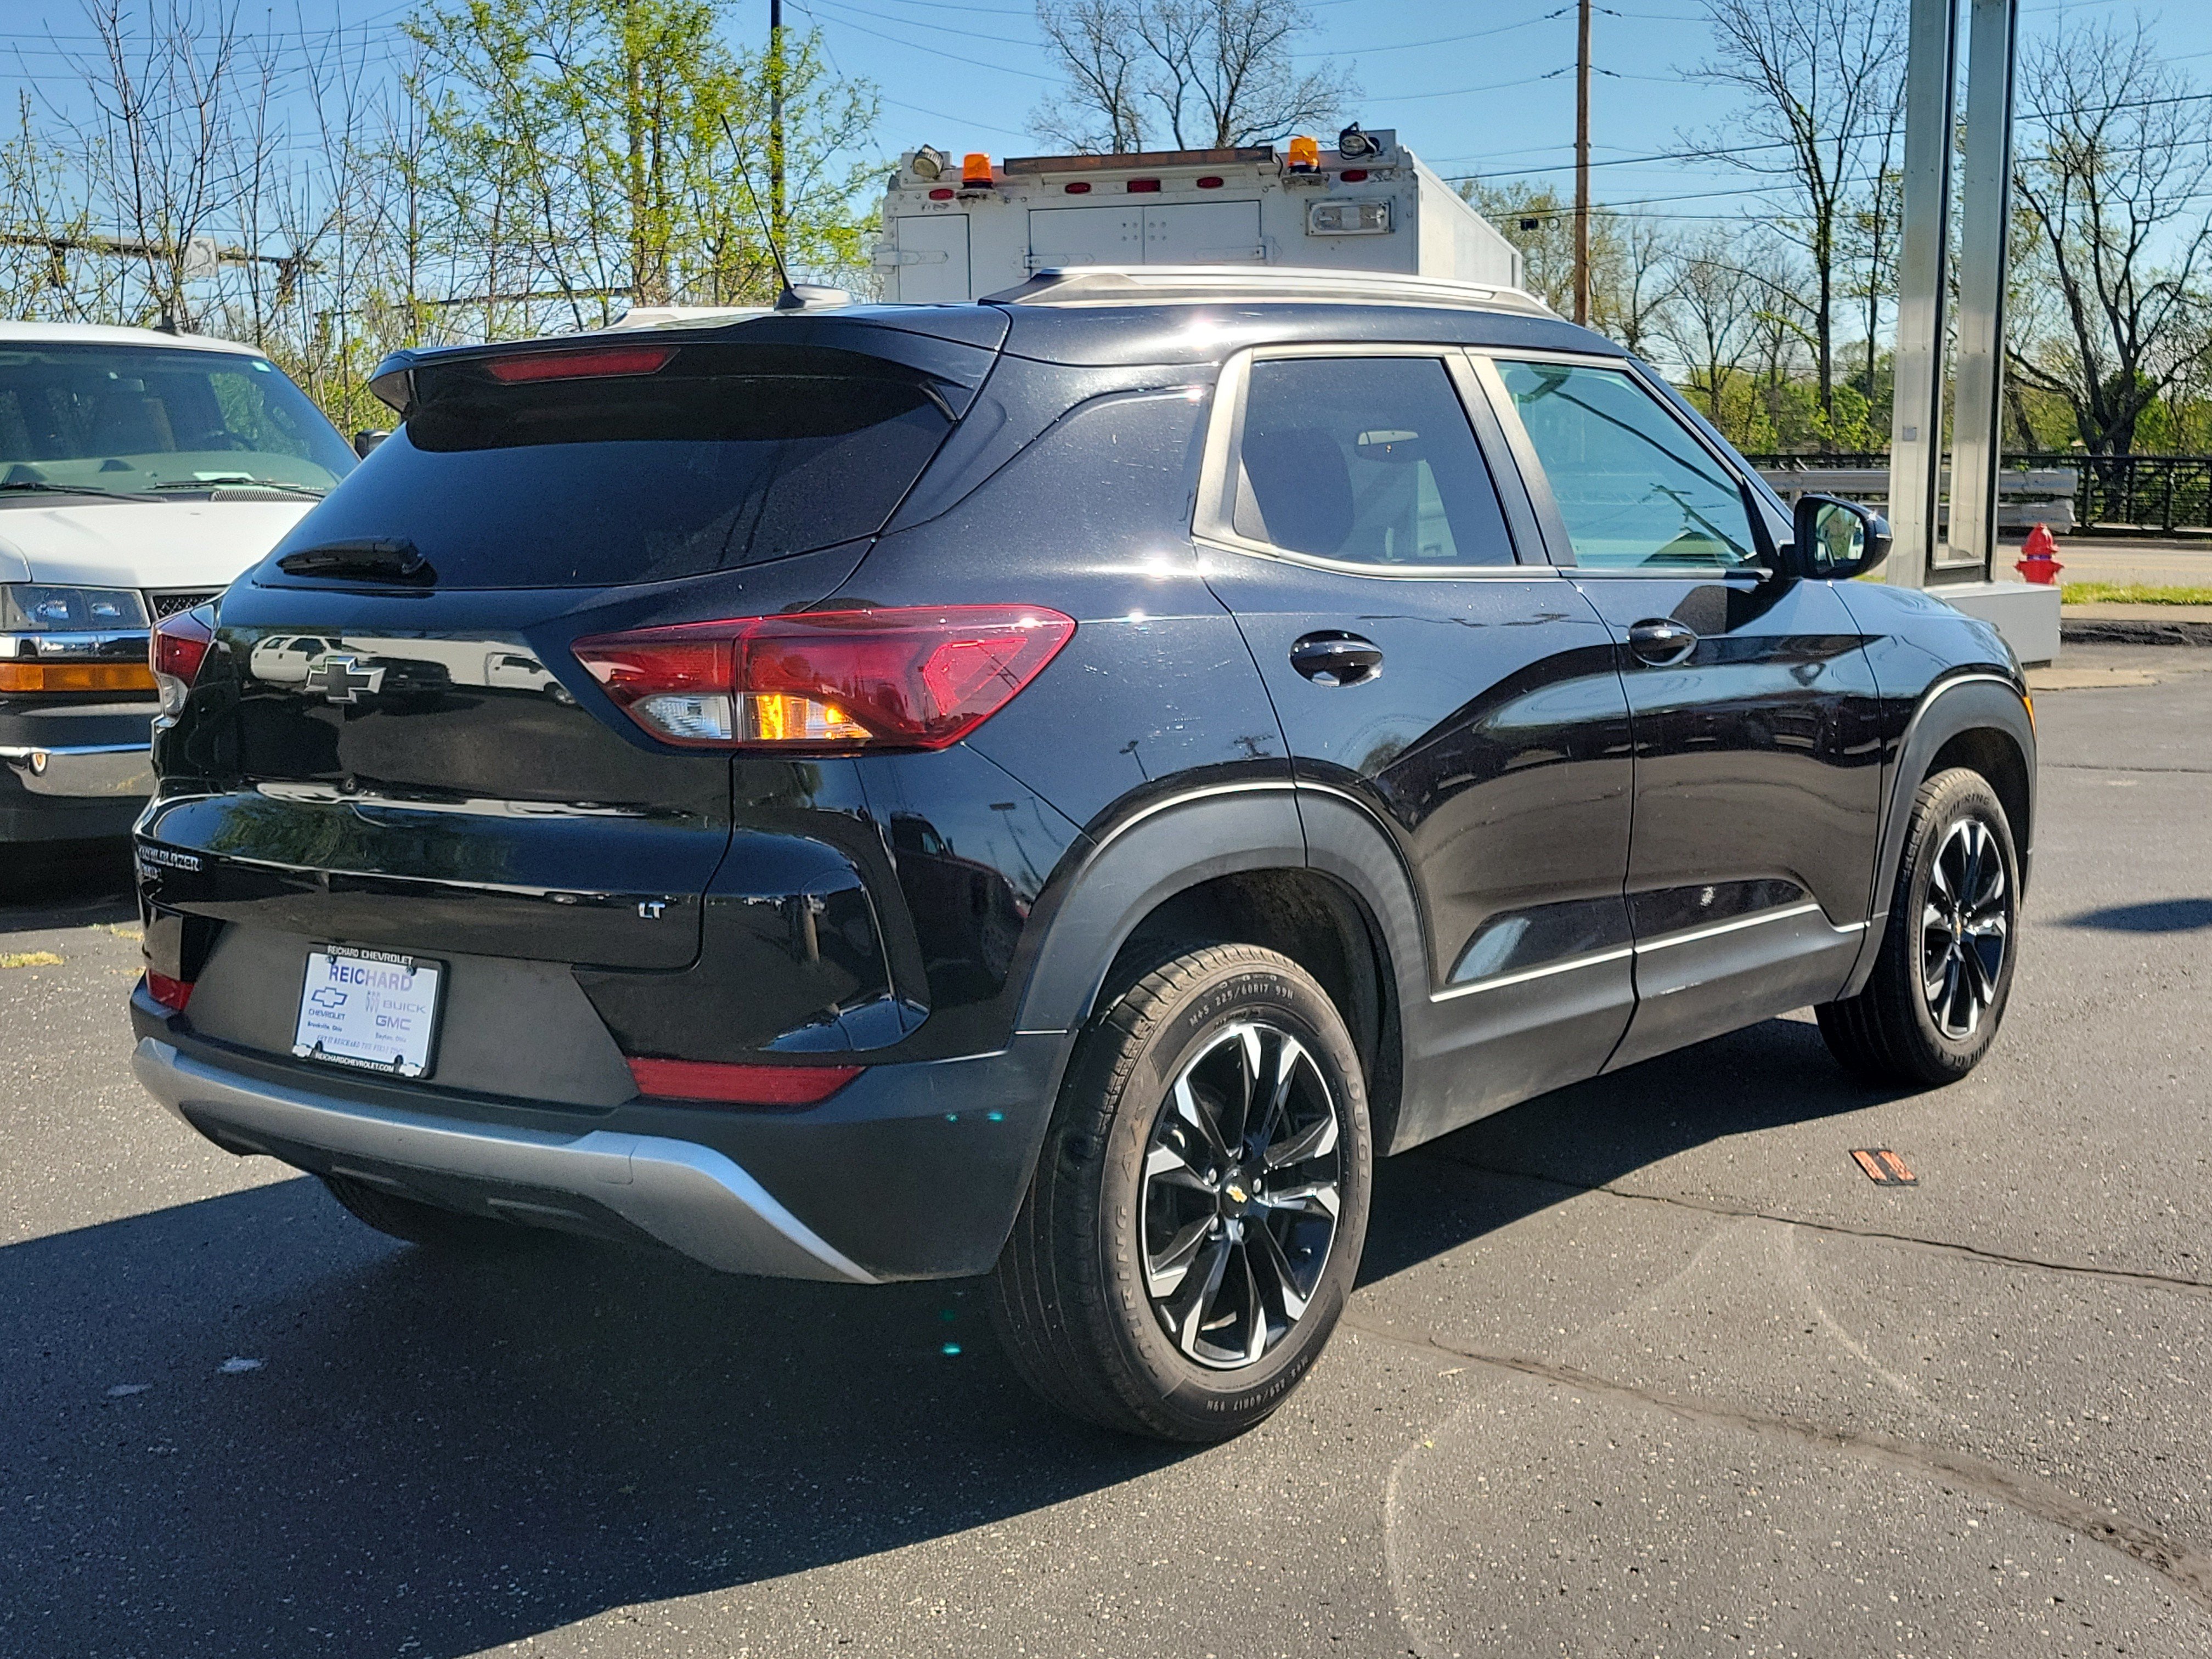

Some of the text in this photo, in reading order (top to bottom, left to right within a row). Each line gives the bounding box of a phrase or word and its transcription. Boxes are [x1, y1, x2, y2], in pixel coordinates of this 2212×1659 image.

[638, 902, 665, 919] LT
[328, 945, 414, 966] REICHARD CHEVROLET
[329, 964, 413, 992] REICHARD
[1215, 984, 1269, 1006] 225/60R17
[308, 1008, 346, 1021] CHEVROLET
[383, 1000, 427, 1014] BUICK
[376, 1015, 411, 1031] GMC
[315, 1053, 394, 1073] REICHARDCHEVROLET.COM
